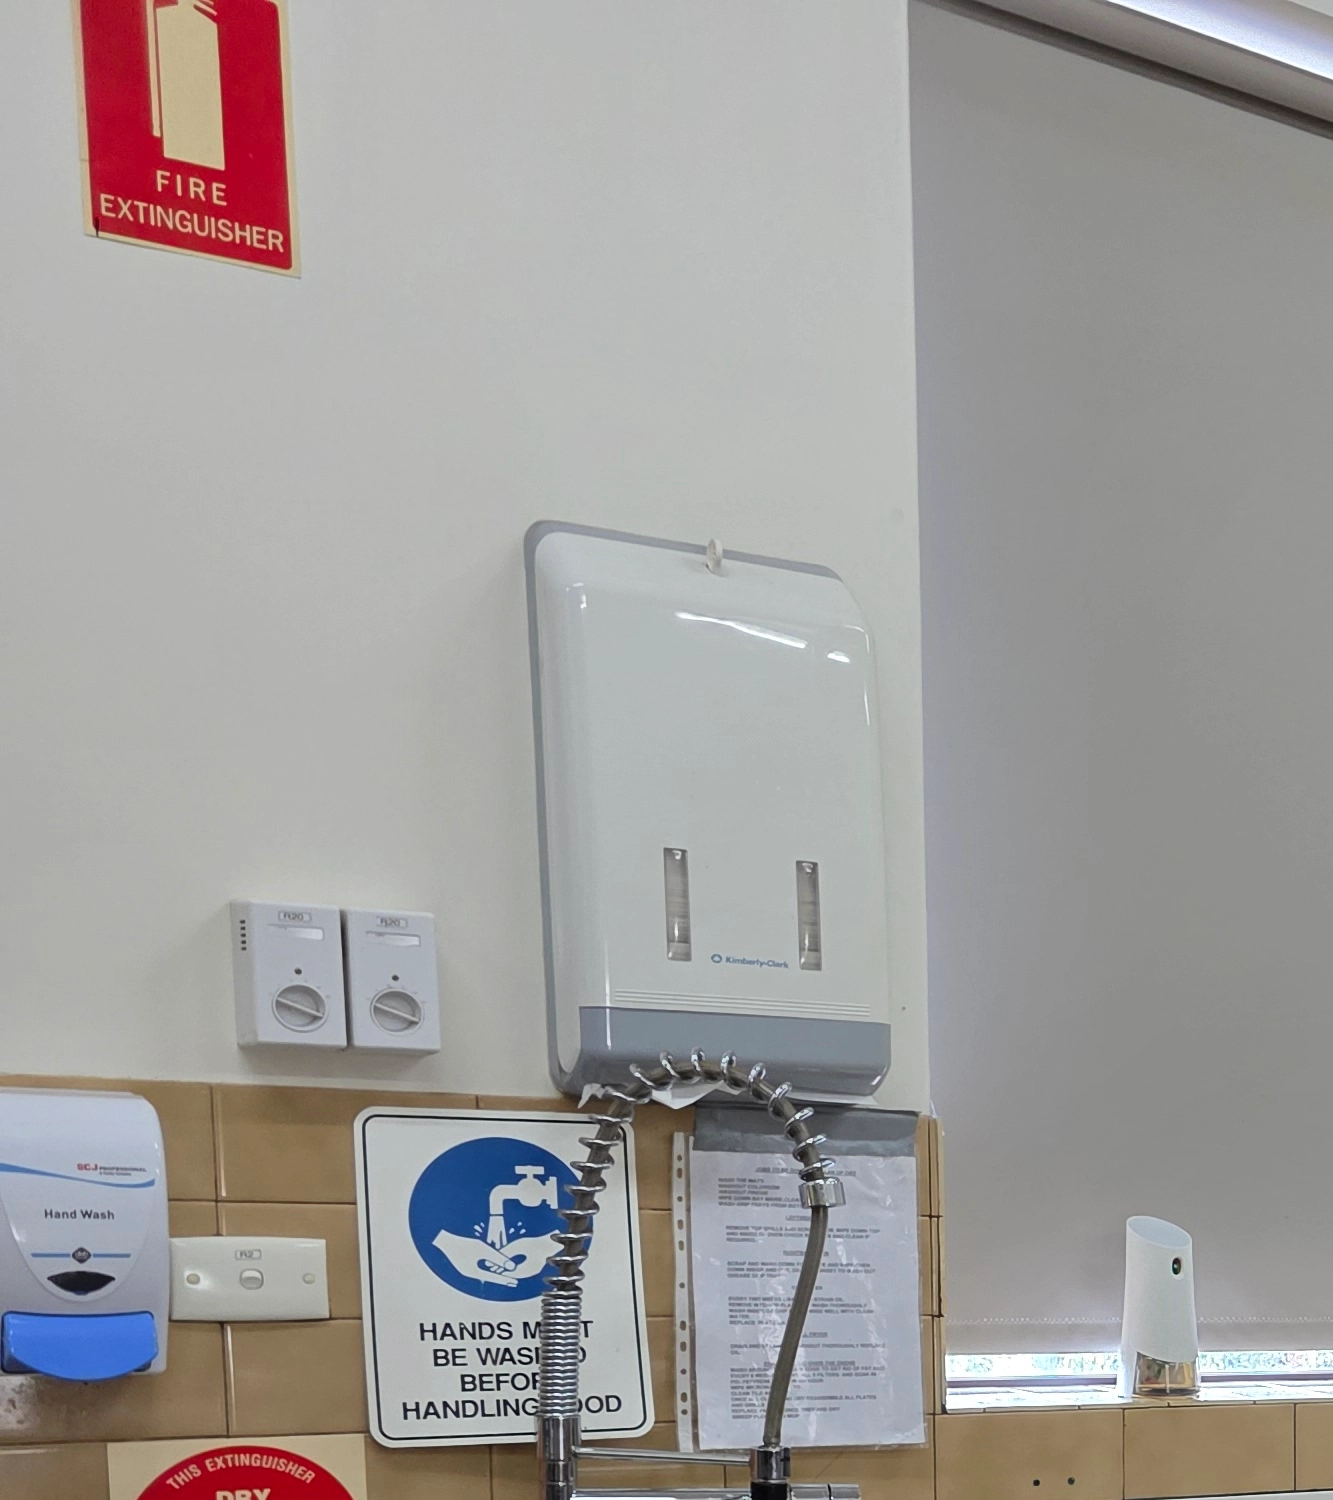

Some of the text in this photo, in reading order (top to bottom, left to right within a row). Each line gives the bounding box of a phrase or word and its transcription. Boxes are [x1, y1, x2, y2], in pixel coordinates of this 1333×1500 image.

[156, 170, 228, 206] FIRE
[100, 193, 284, 253] EXTINGUISHER
[725, 956, 789, 969] Kimberly-Clark
[44, 1209, 115, 1220] Hand Wash
[419, 1320, 594, 1341] HANDS MT
[433, 1348, 468, 1367] BE
[460, 1372, 541, 1392] BEFO
[402, 1395, 622, 1420] HANDLING OD
[166, 1453, 316, 1489] THIS EXTINGUISHER
